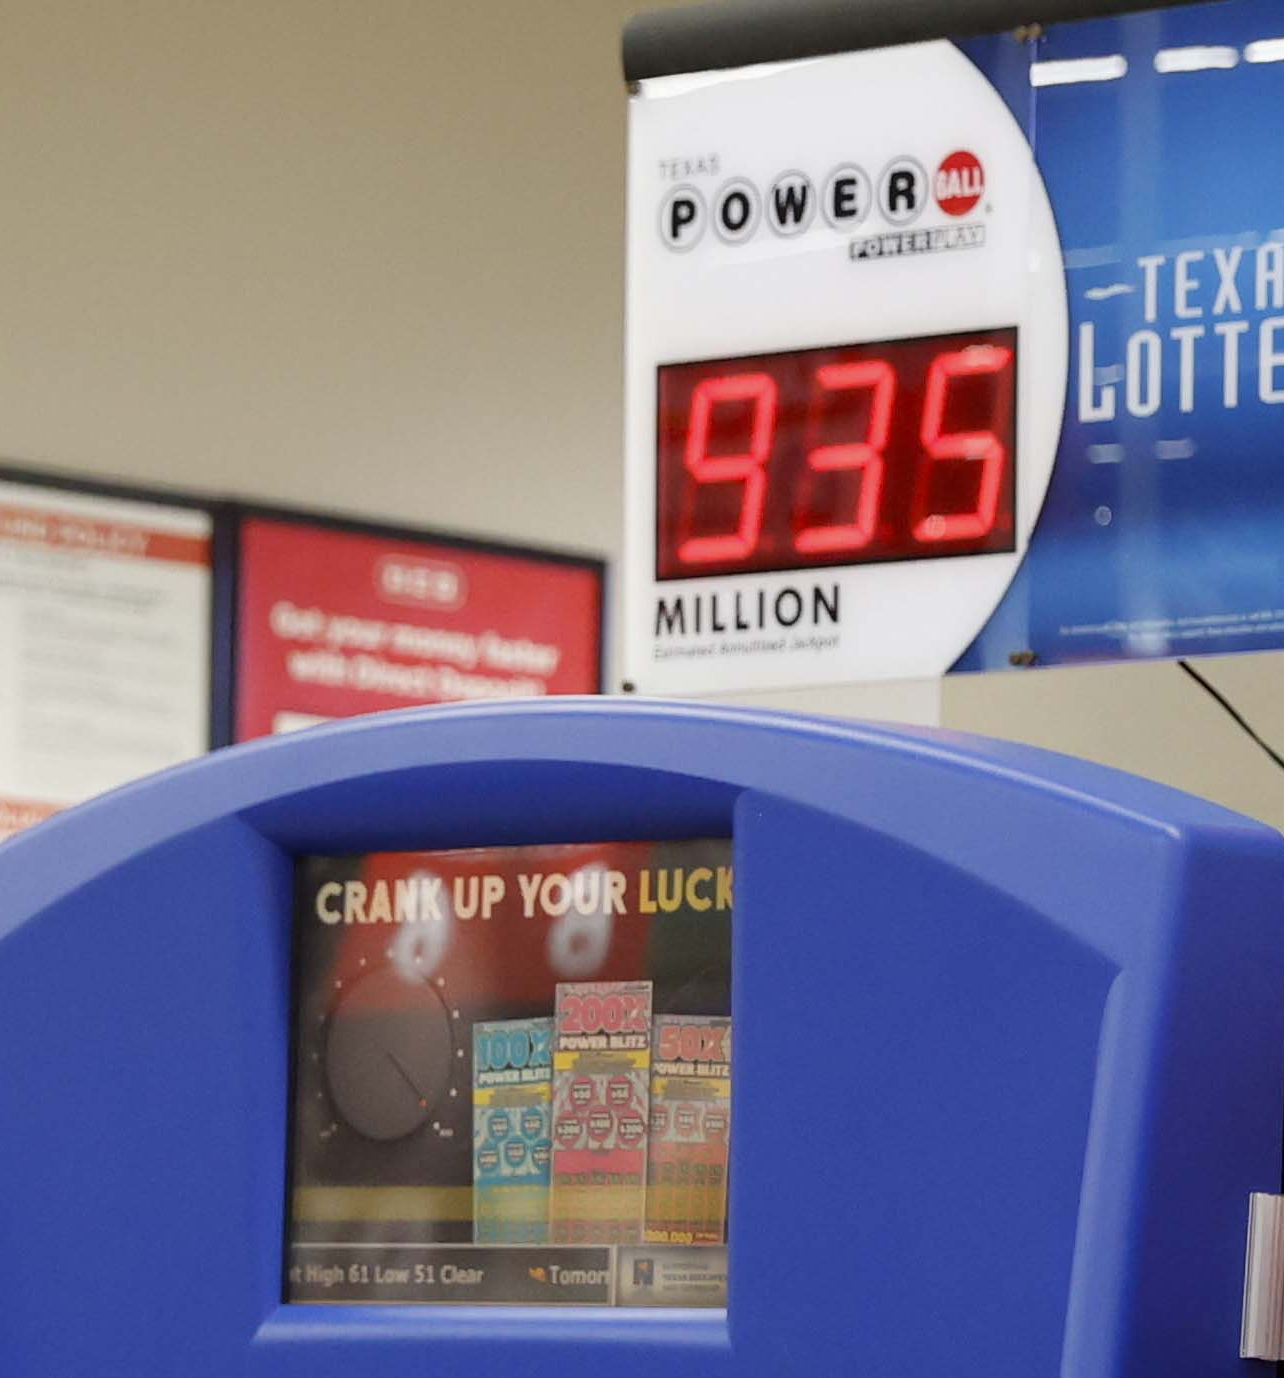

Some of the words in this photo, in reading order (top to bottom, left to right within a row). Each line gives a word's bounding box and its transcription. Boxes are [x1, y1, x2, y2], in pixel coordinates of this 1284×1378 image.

[676, 343, 1015, 564] 935
[654, 583, 840, 637] MILLION
[315, 876, 445, 924] CRANK
[453, 875, 506, 920] UP
[518, 869, 629, 917] YOUR
[560, 994, 648, 1032] 200X
[559, 1036, 607, 1050] POWER
[307, 1264, 345, 1292] High
[349, 1265, 370, 1283] 61
[375, 1265, 408, 1284] Low
[415, 1264, 435, 1283] 51
[440, 1264, 484, 1285] Clear
